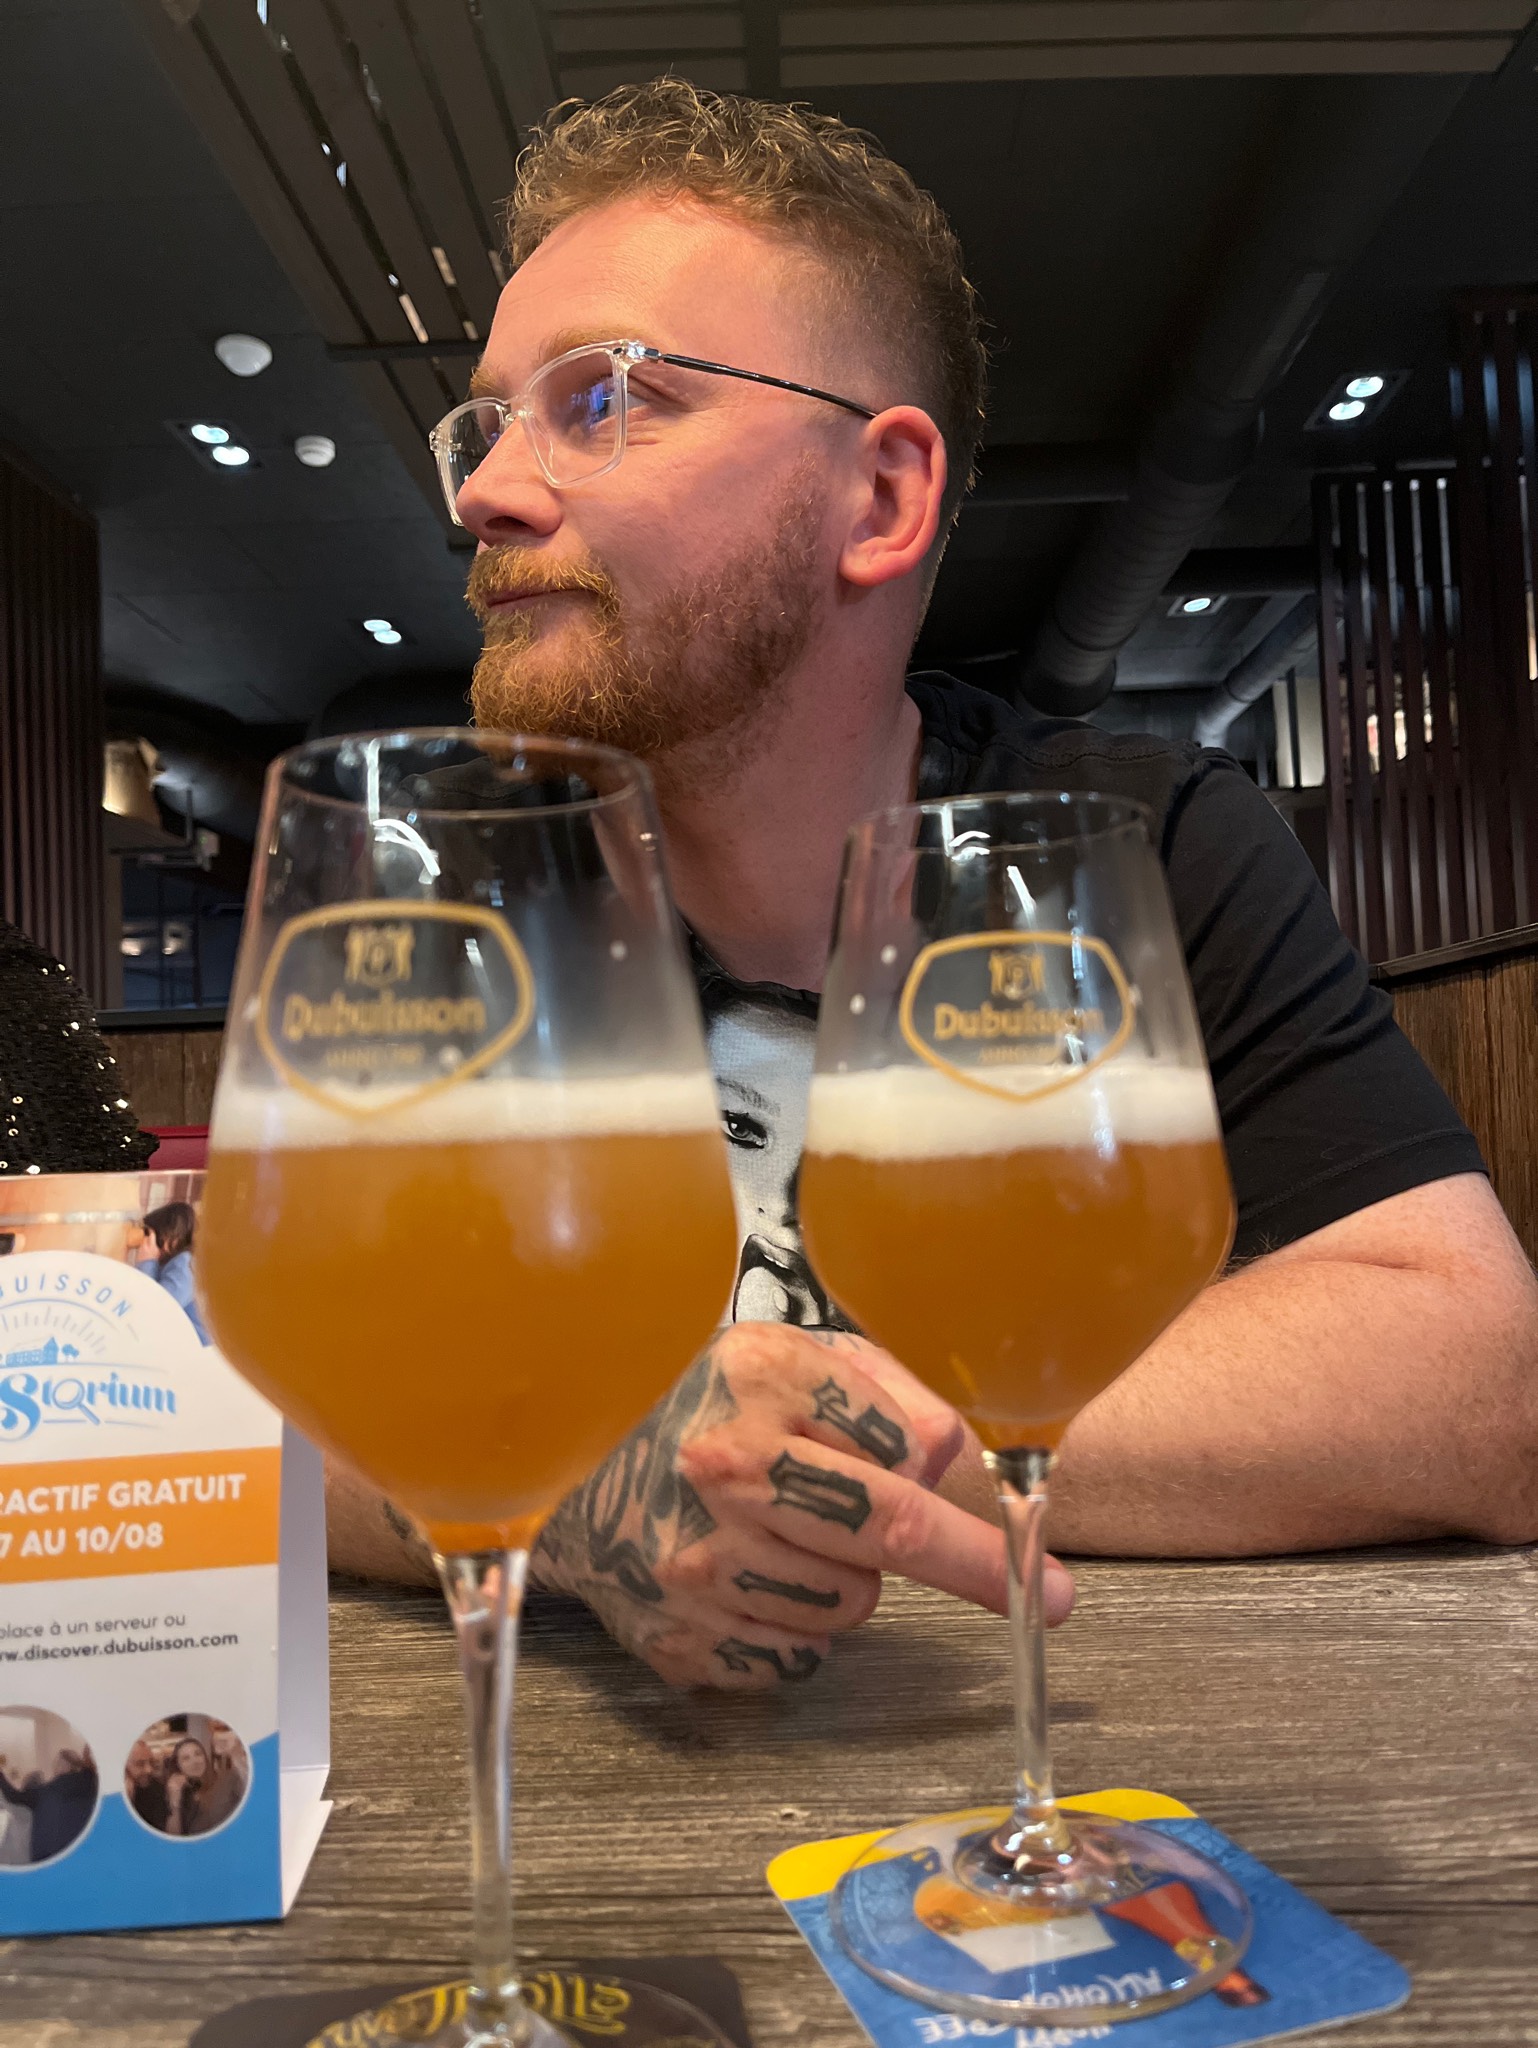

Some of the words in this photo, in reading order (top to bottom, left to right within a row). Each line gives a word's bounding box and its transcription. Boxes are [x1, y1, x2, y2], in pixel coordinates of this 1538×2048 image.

[0, 1272, 132, 1318] UISSON
[0, 1483, 101, 1516] ACTIF
[107, 1473, 247, 1509] GRATUIT
[20, 1528, 67, 1557] AU
[75, 1521, 163, 1553] 10/08
[50, 1620, 61, 1636] à
[67, 1621, 88, 1634] un
[95, 1615, 157, 1632] serveur
[164, 1613, 186, 1627] ou
